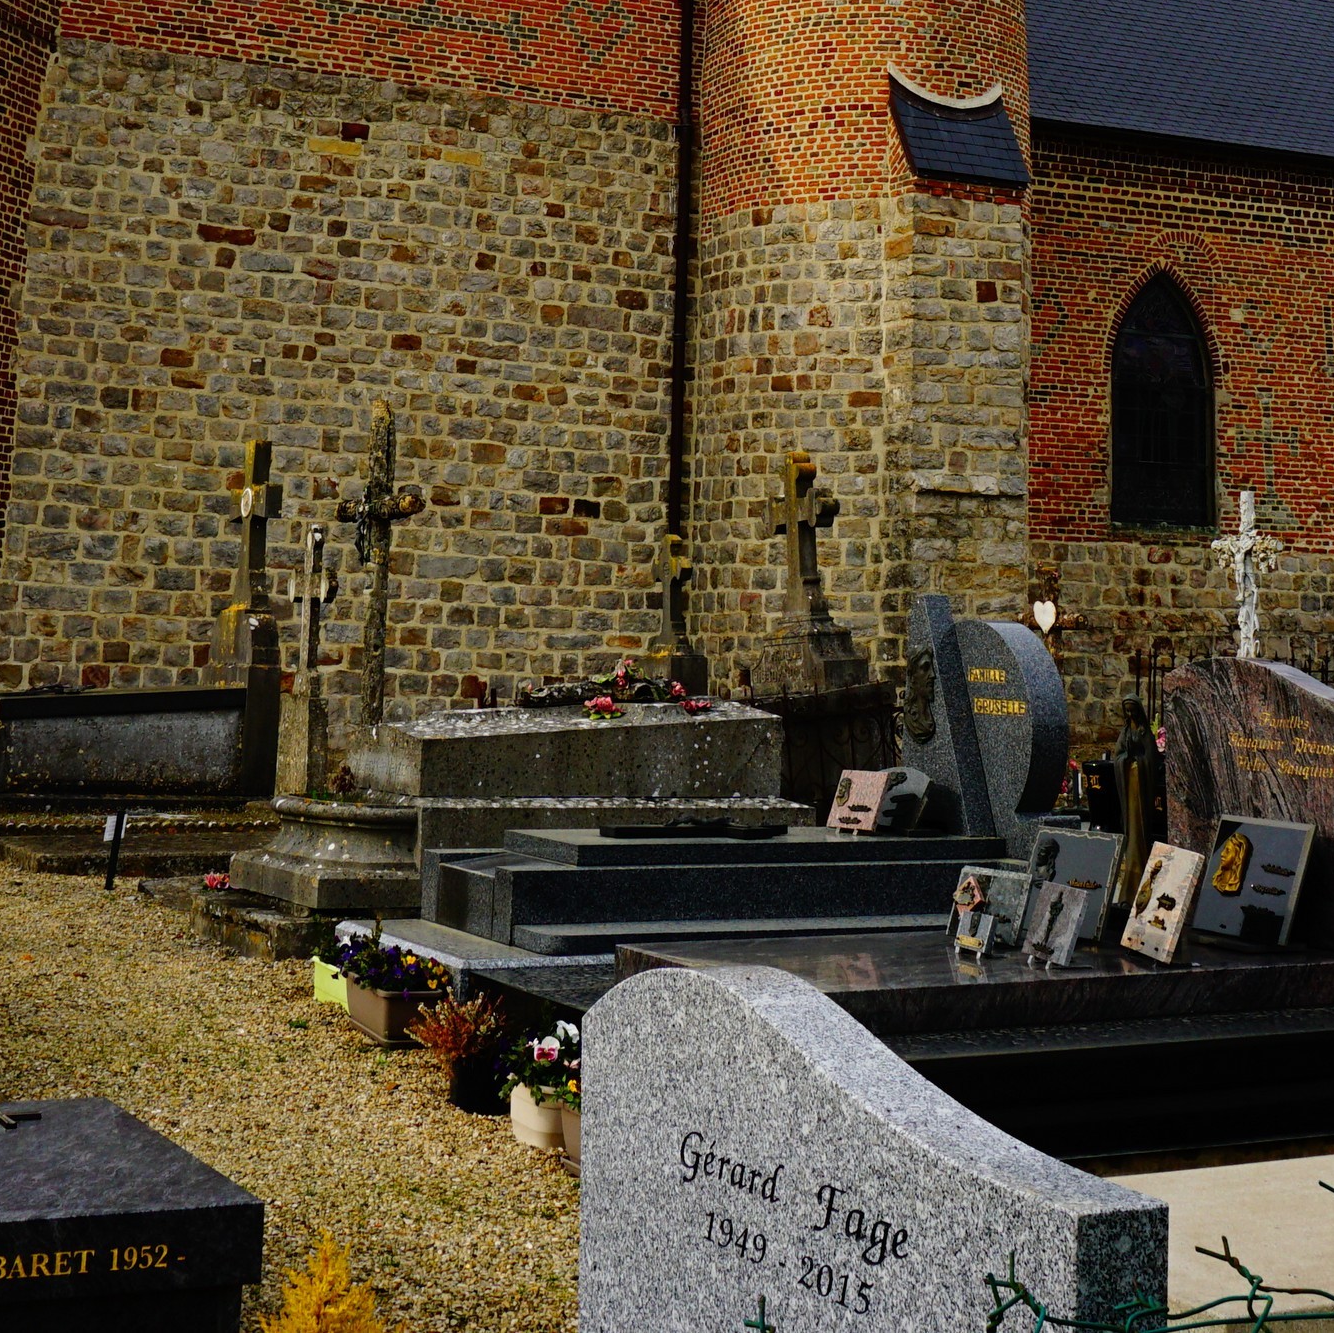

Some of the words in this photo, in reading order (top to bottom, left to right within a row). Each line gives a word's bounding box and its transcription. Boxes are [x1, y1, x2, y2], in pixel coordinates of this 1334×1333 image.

[970, 668, 1005, 682] FAMILLE
[975, 699, 1026, 715] GRUSELLE
[680, 1131, 785, 1203] Gérard
[814, 1184, 908, 1266] Fage
[109, 1244, 169, 1272] 1952
[704, 1212, 767, 1264] 1949
[798, 1256, 874, 1315] 2015
